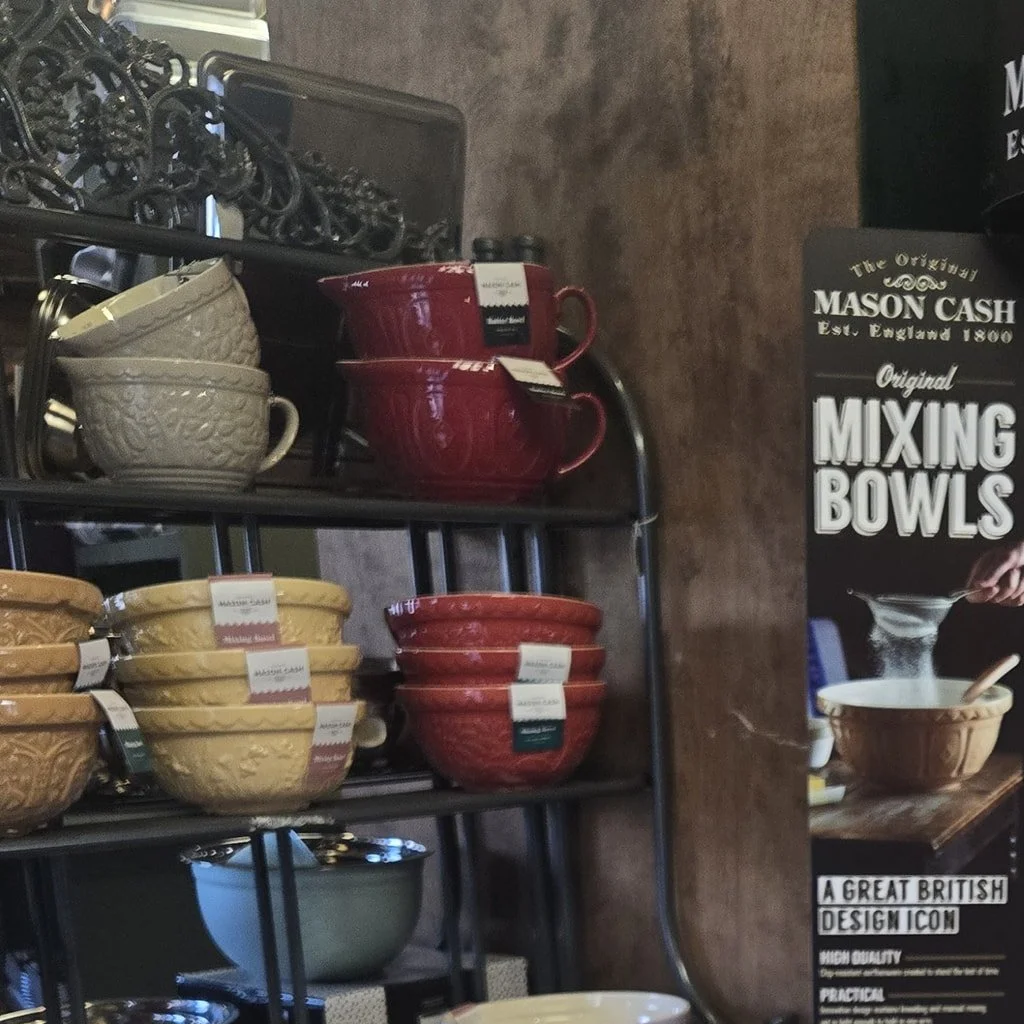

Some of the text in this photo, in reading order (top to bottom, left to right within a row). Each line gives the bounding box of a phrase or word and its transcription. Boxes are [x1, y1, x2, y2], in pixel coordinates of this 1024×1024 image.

[850, 252, 978, 282] The Original
[813, 289, 1016, 324] MASON CASH
[818, 320, 1013, 343] Est. England 1800
[875, 363, 959, 398] Original
[813, 396, 1016, 472] MIXING
[813, 467, 1015, 540] BOWLS
[823, 879, 1005, 900] A GREAT BRITISH
[822, 909, 955, 931] DESIGN ICON
[819, 949, 902, 965] HIGH QUALITY
[819, 986, 885, 1002] PRACTICAL
